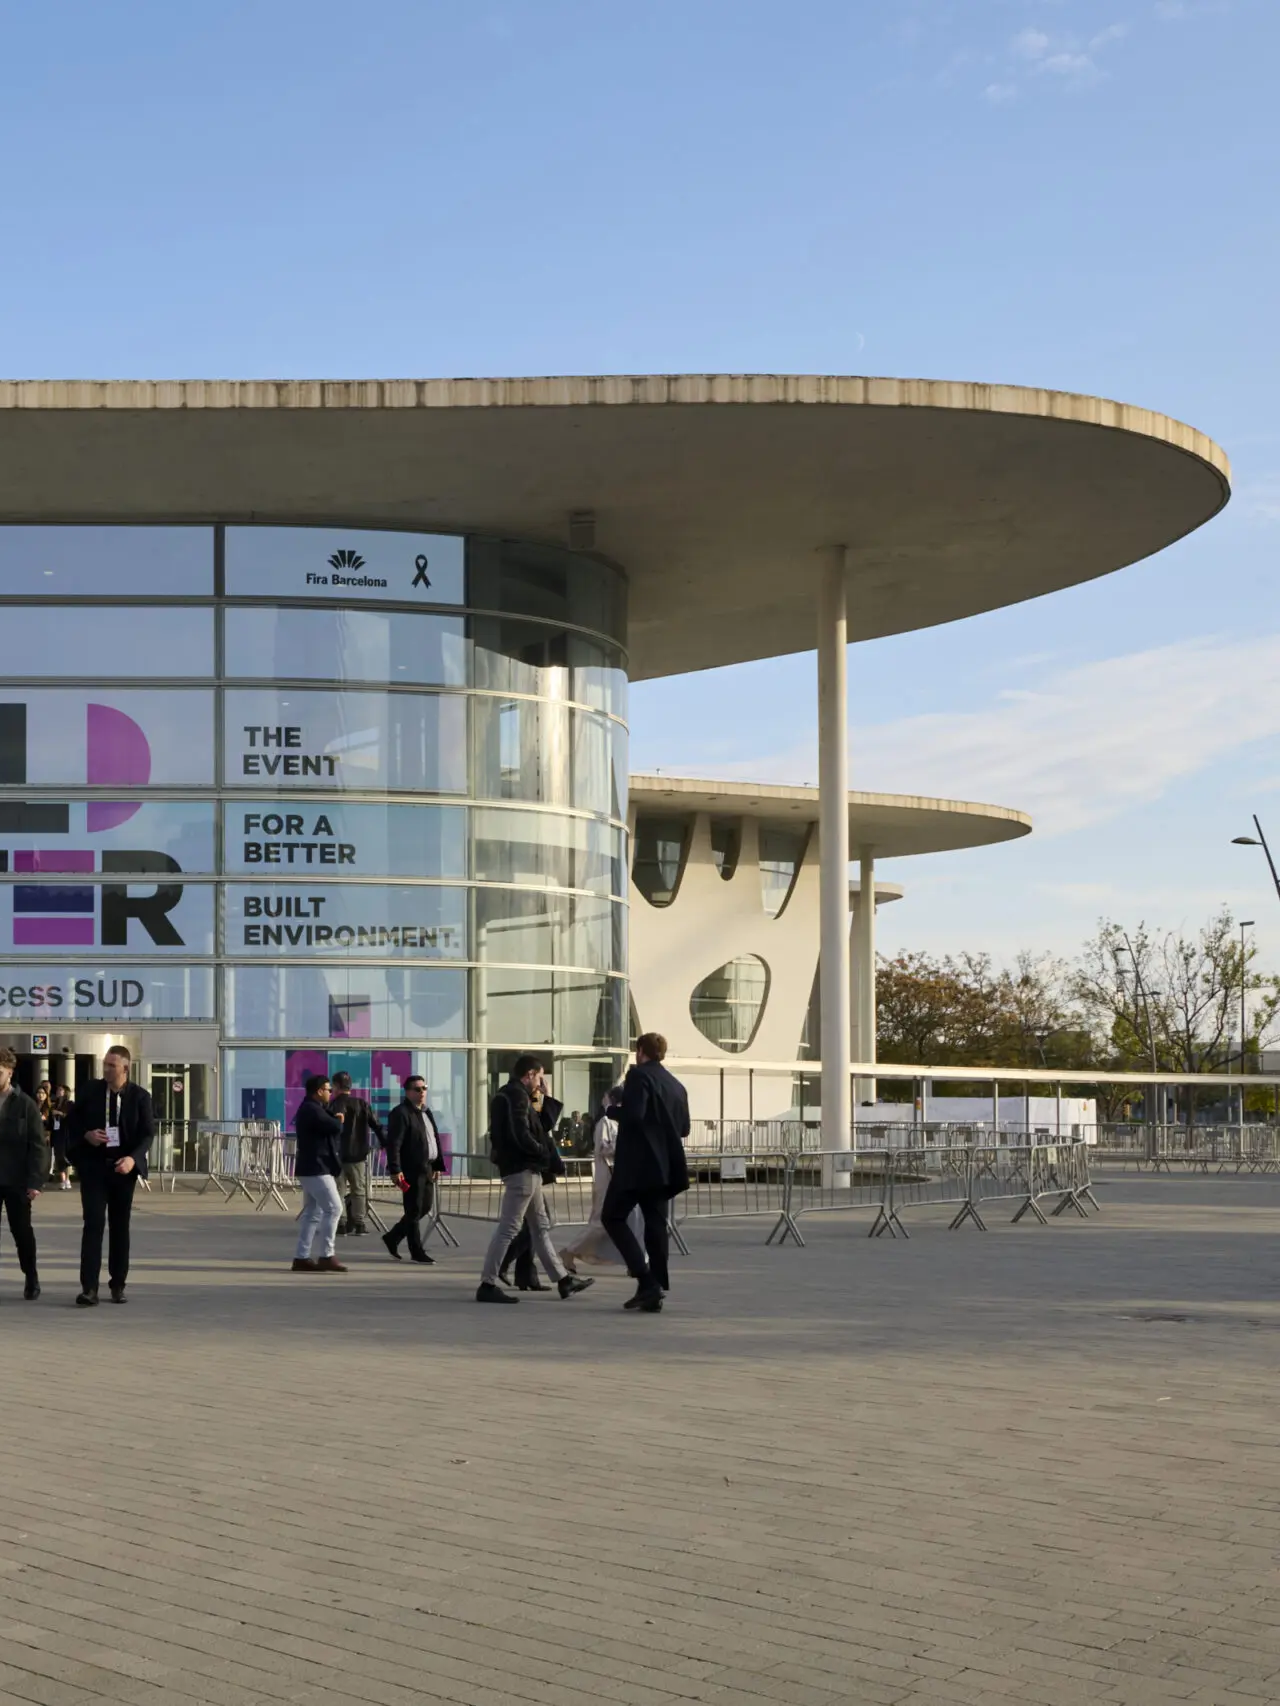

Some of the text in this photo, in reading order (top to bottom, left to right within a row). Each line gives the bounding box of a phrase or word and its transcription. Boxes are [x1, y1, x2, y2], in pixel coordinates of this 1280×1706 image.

[305, 572, 388, 588] Fira Barcelona
[243, 726, 302, 748] THE
[243, 754, 338, 777] EVENT
[243, 813, 335, 837] FOR A
[243, 841, 357, 866] BETTER
[243, 896, 326, 918] BUILT
[243, 924, 460, 949] ENVIRONMENT.
[74, 979, 145, 1008] SUD
